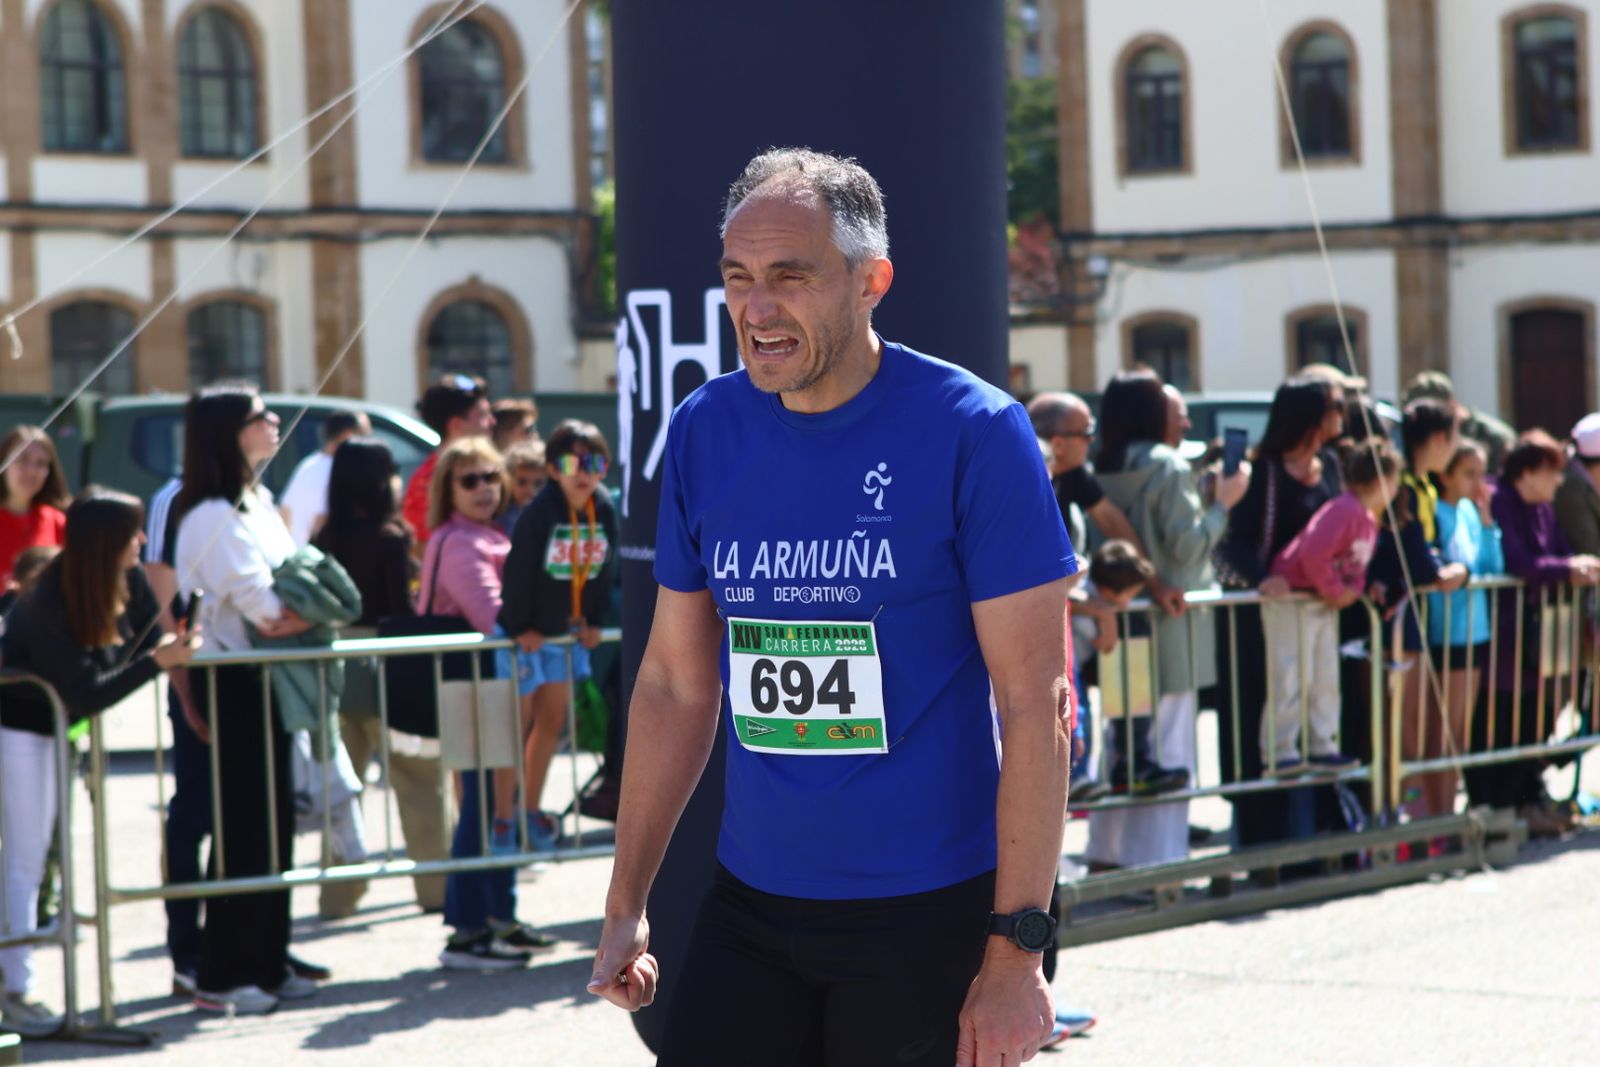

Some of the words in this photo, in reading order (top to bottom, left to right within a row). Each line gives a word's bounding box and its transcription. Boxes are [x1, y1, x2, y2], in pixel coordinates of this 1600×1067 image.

[856, 514, 892, 523] Salamanca
[713, 540, 740, 579] LA
[749, 529, 897, 579] ARMUÑA
[725, 587, 755, 602] CLUB
[773, 585, 861, 604] DEPORTIVO
[733, 624, 762, 649] XIV
[765, 626, 785, 639] SAN
[797, 627, 868, 639] FERNANDO
[765, 638, 832, 653] CARRERA
[751, 658, 856, 715] 694
